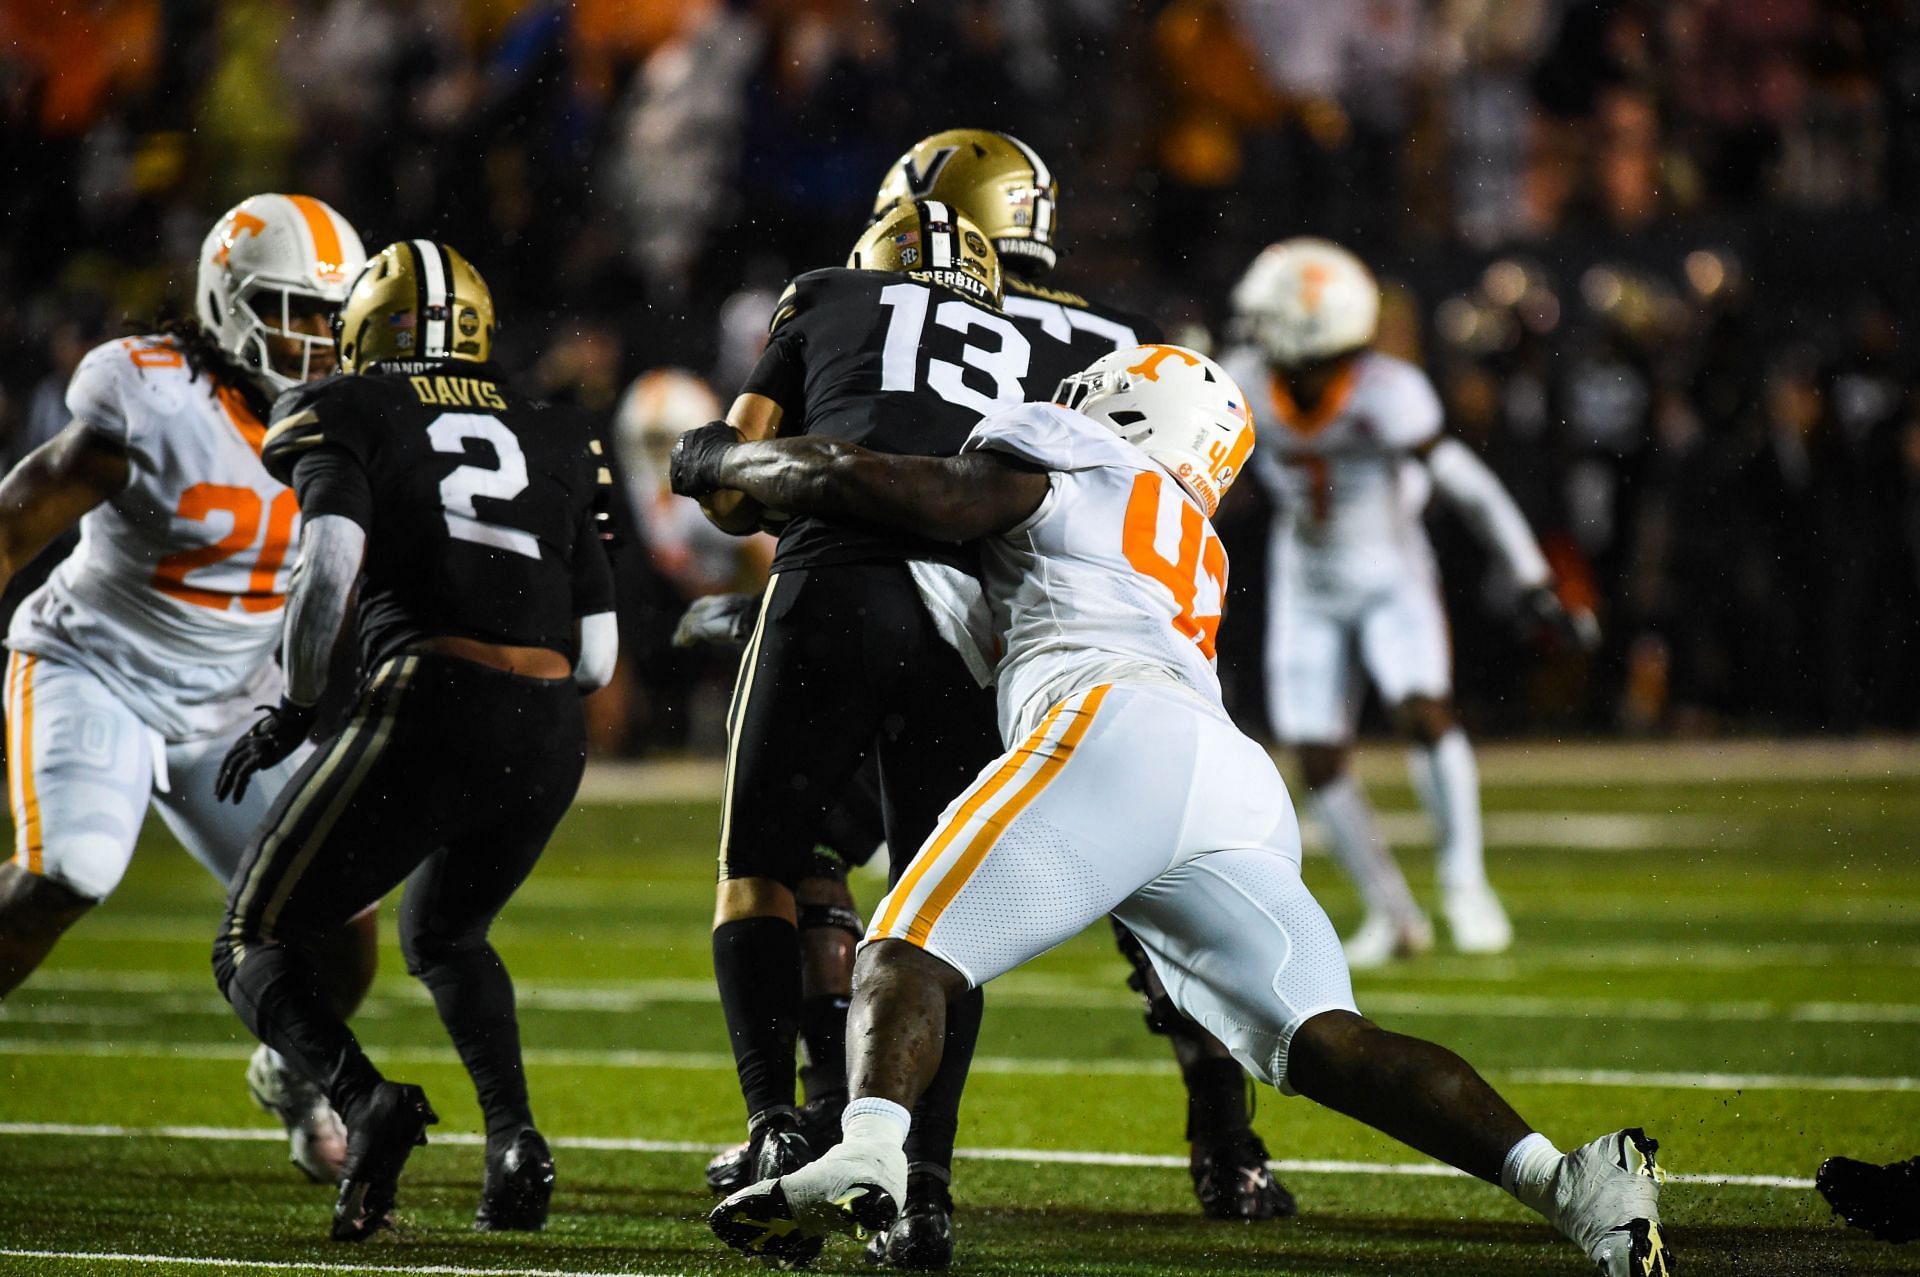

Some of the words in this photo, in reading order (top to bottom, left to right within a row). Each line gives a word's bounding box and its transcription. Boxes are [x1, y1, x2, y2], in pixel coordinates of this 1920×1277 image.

[899, 146, 959, 197] V
[212, 211, 267, 269] T
[900, 248, 918, 266] SEC
[880, 282, 1031, 416] 13
[1127, 344, 1201, 382] T
[409, 375, 508, 411] DAVIS
[1207, 440, 1229, 474] 4
[425, 413, 542, 560] 2
[1192, 473, 1218, 519] TENNES
[150, 482, 301, 613] 20
